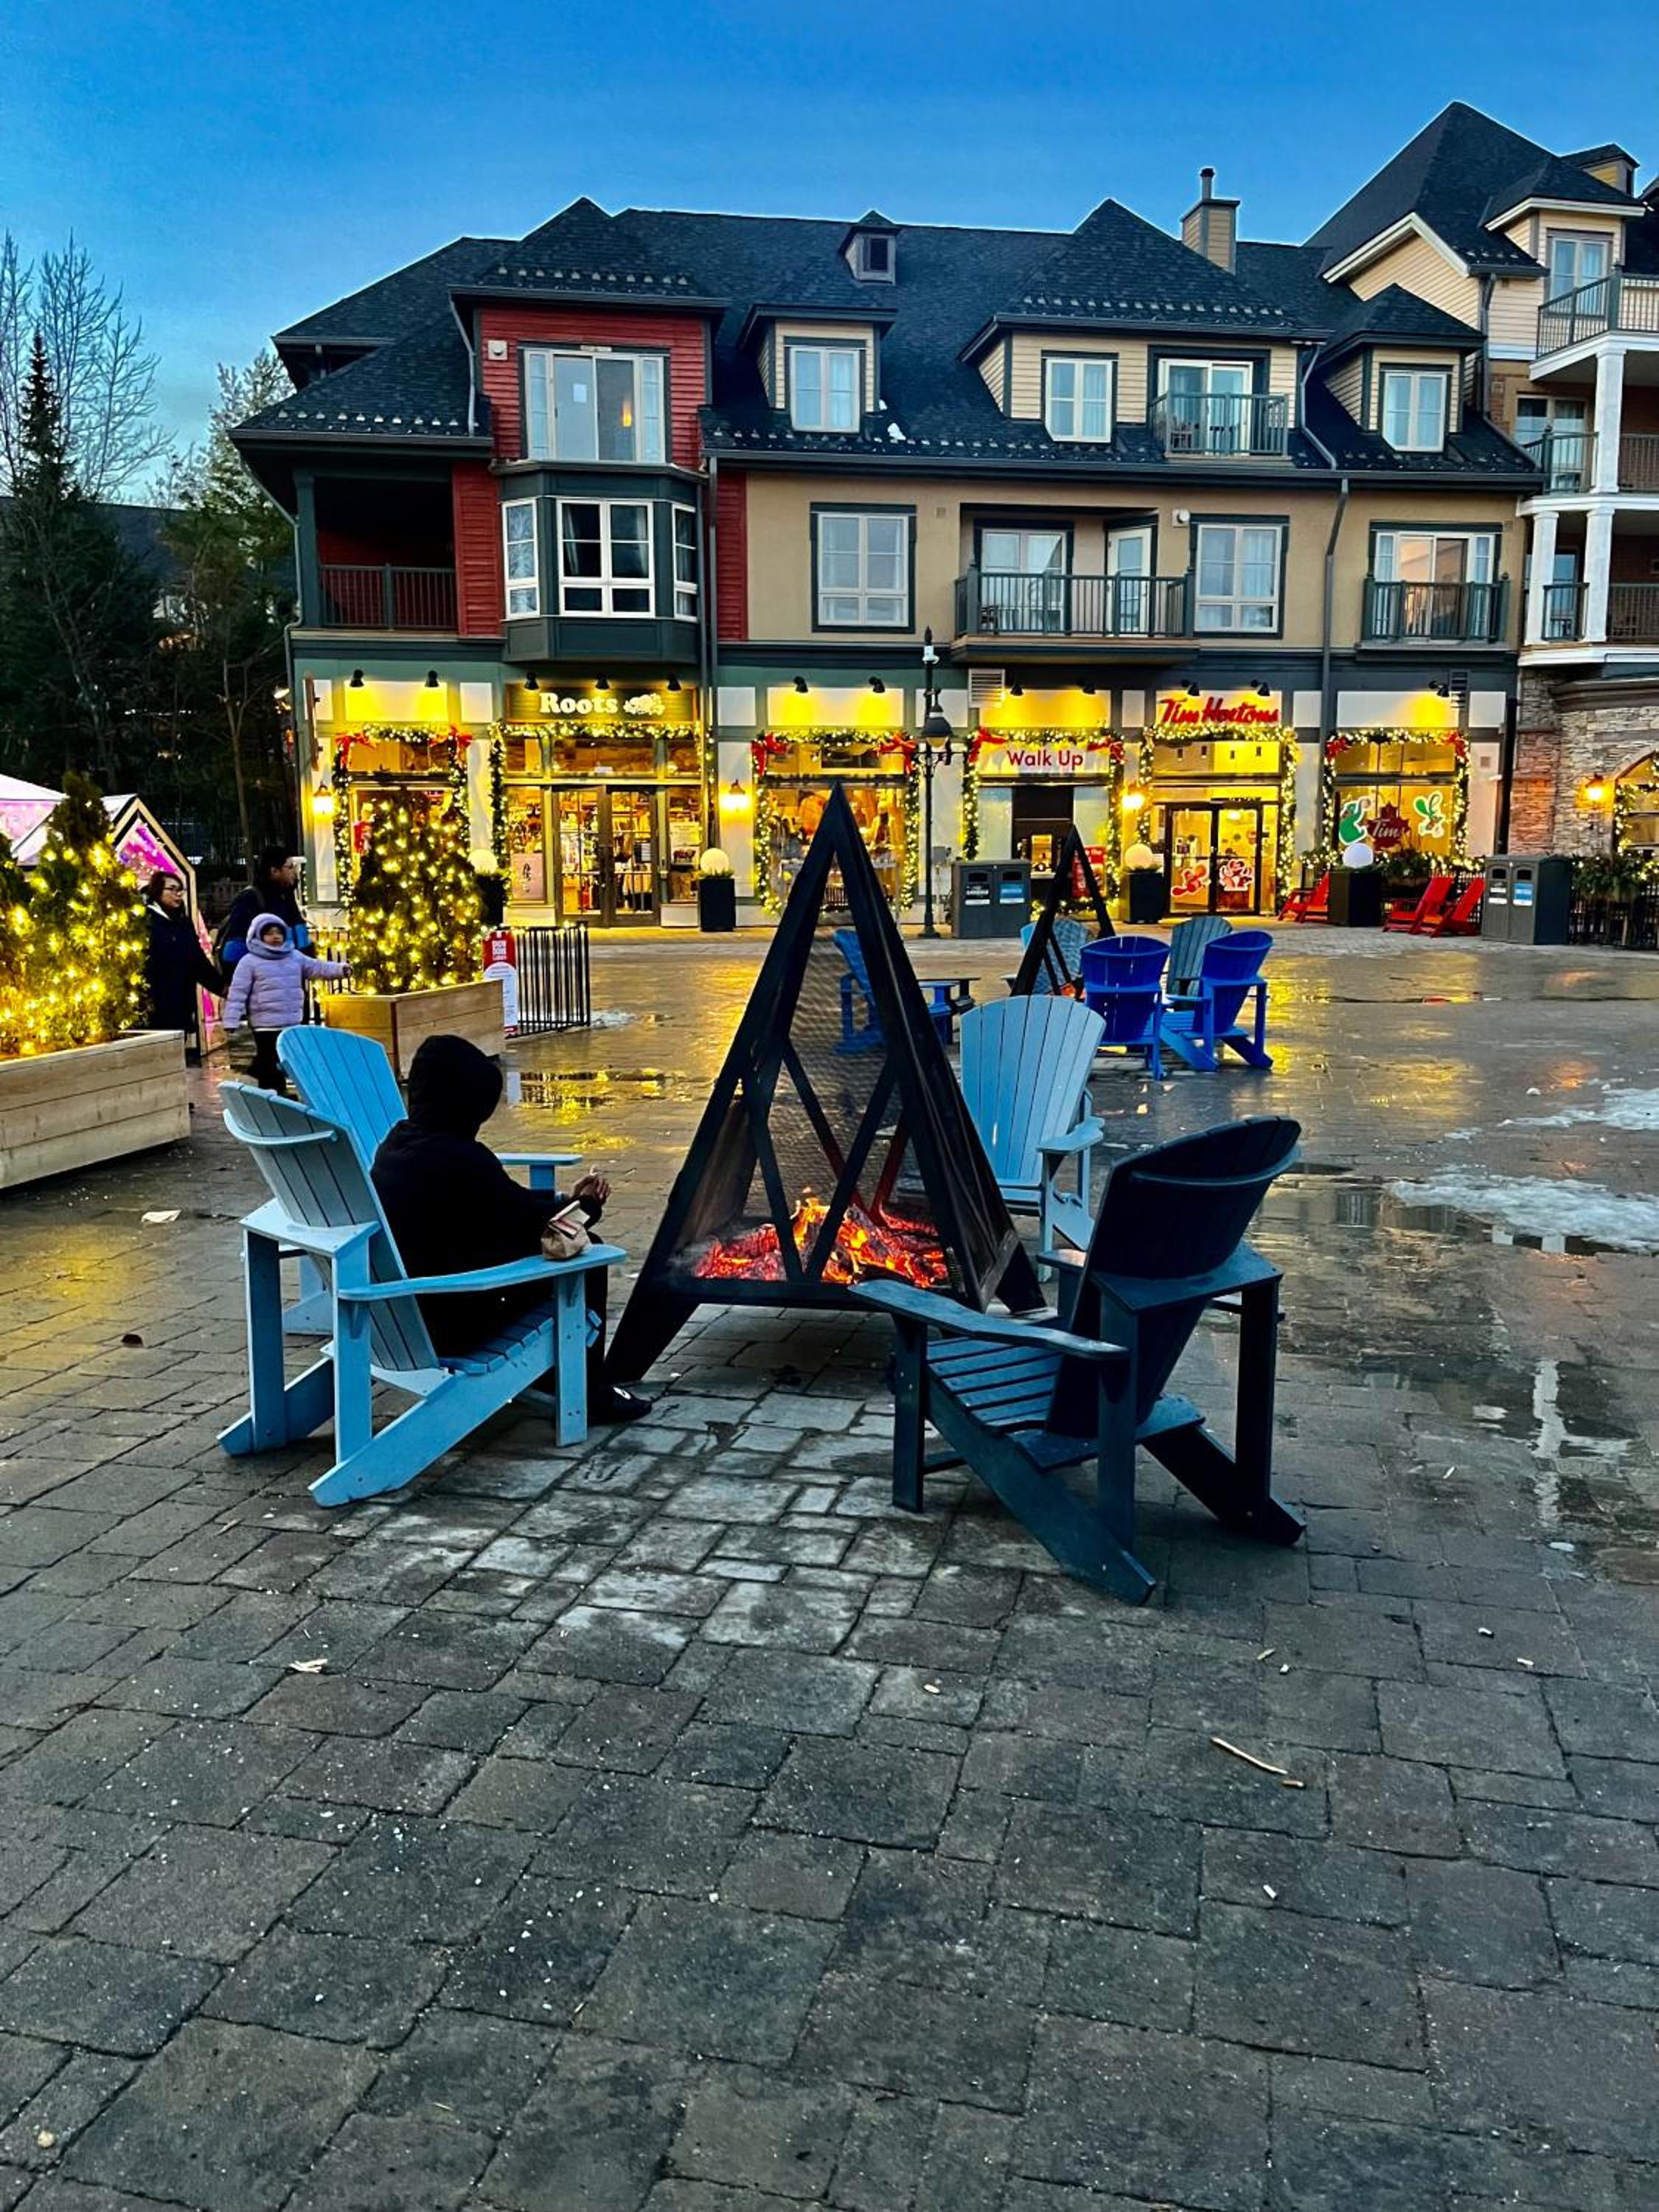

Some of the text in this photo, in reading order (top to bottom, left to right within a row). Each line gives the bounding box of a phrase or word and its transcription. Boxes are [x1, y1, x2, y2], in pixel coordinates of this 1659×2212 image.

[540, 692, 619, 714] Roots
[1160, 696, 1279, 723] Tim Hortons
[1006, 750, 1084, 771] Walk Up
